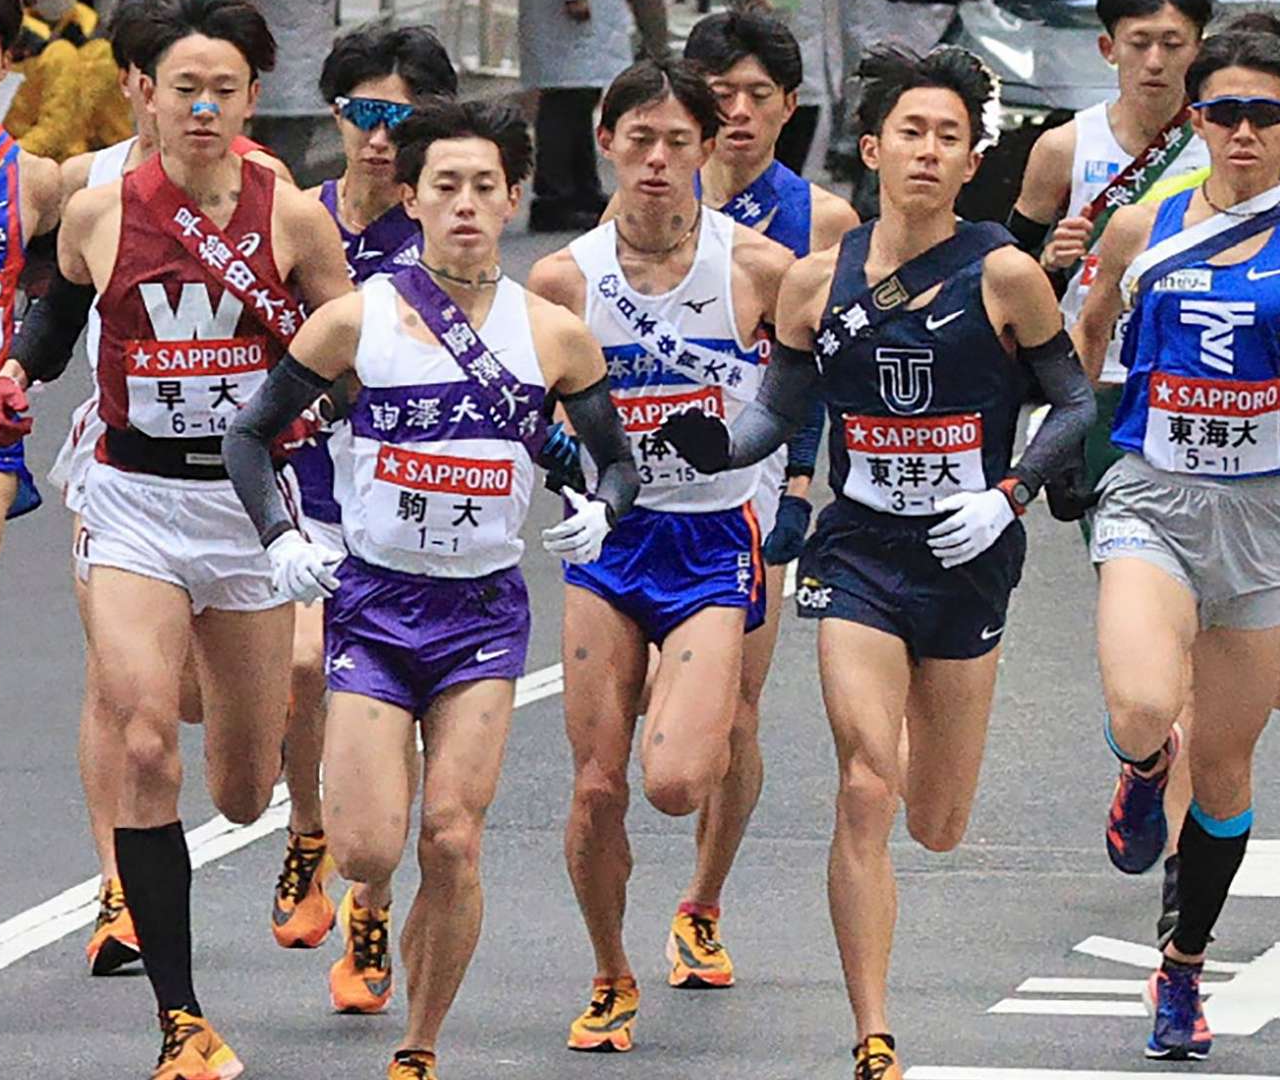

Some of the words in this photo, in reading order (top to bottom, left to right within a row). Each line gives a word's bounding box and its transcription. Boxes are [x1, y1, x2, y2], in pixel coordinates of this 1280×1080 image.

[139, 282, 244, 342] W
[156, 344, 261, 370] SAPPORO
[1177, 385, 1278, 411] SAPPORO
[370, 395, 506, 431] 駒澤大
[872, 423, 976, 447] SAPPORO
[1168, 417, 1258, 447] 東海大
[405, 459, 508, 489] SAPPORO
[867, 457, 961, 487] 東洋大
[1185, 451, 1240, 472] 5-11
[418, 527, 459, 553] 1-1
